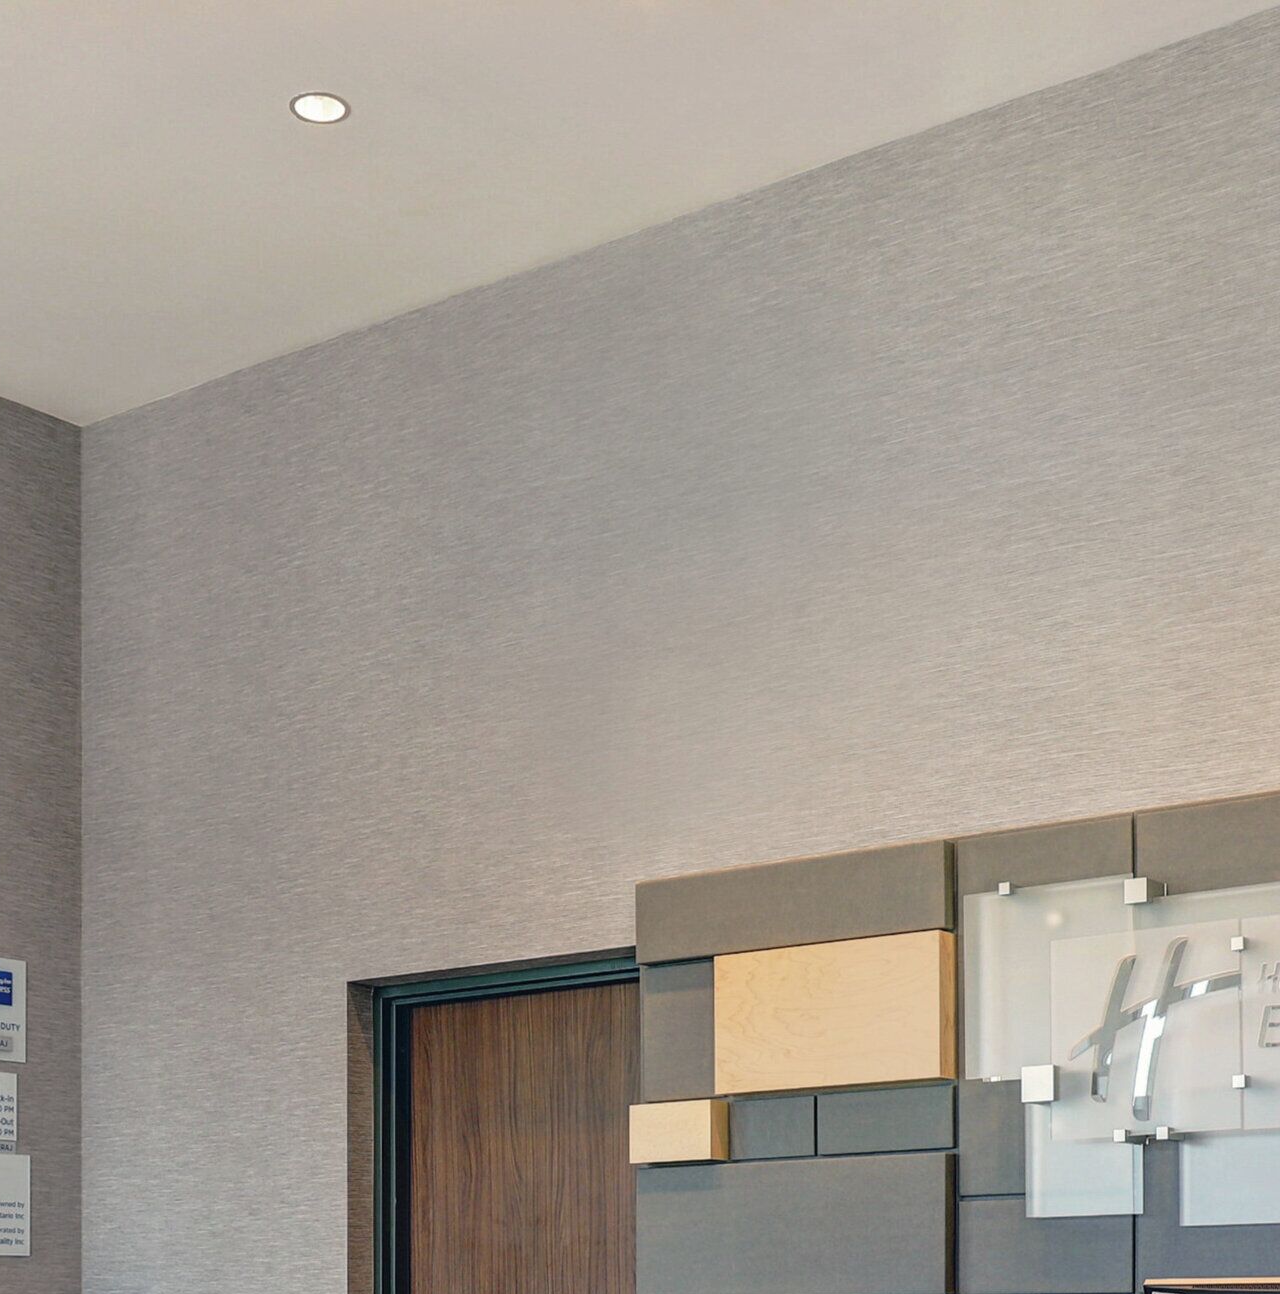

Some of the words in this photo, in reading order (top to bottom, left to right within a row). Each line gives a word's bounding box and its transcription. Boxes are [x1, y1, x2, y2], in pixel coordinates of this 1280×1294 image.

[0, 1022, 20, 1031] DUTY
[4, 1105, 15, 1113] PM
[4, 1128, 15, 1136] PM
